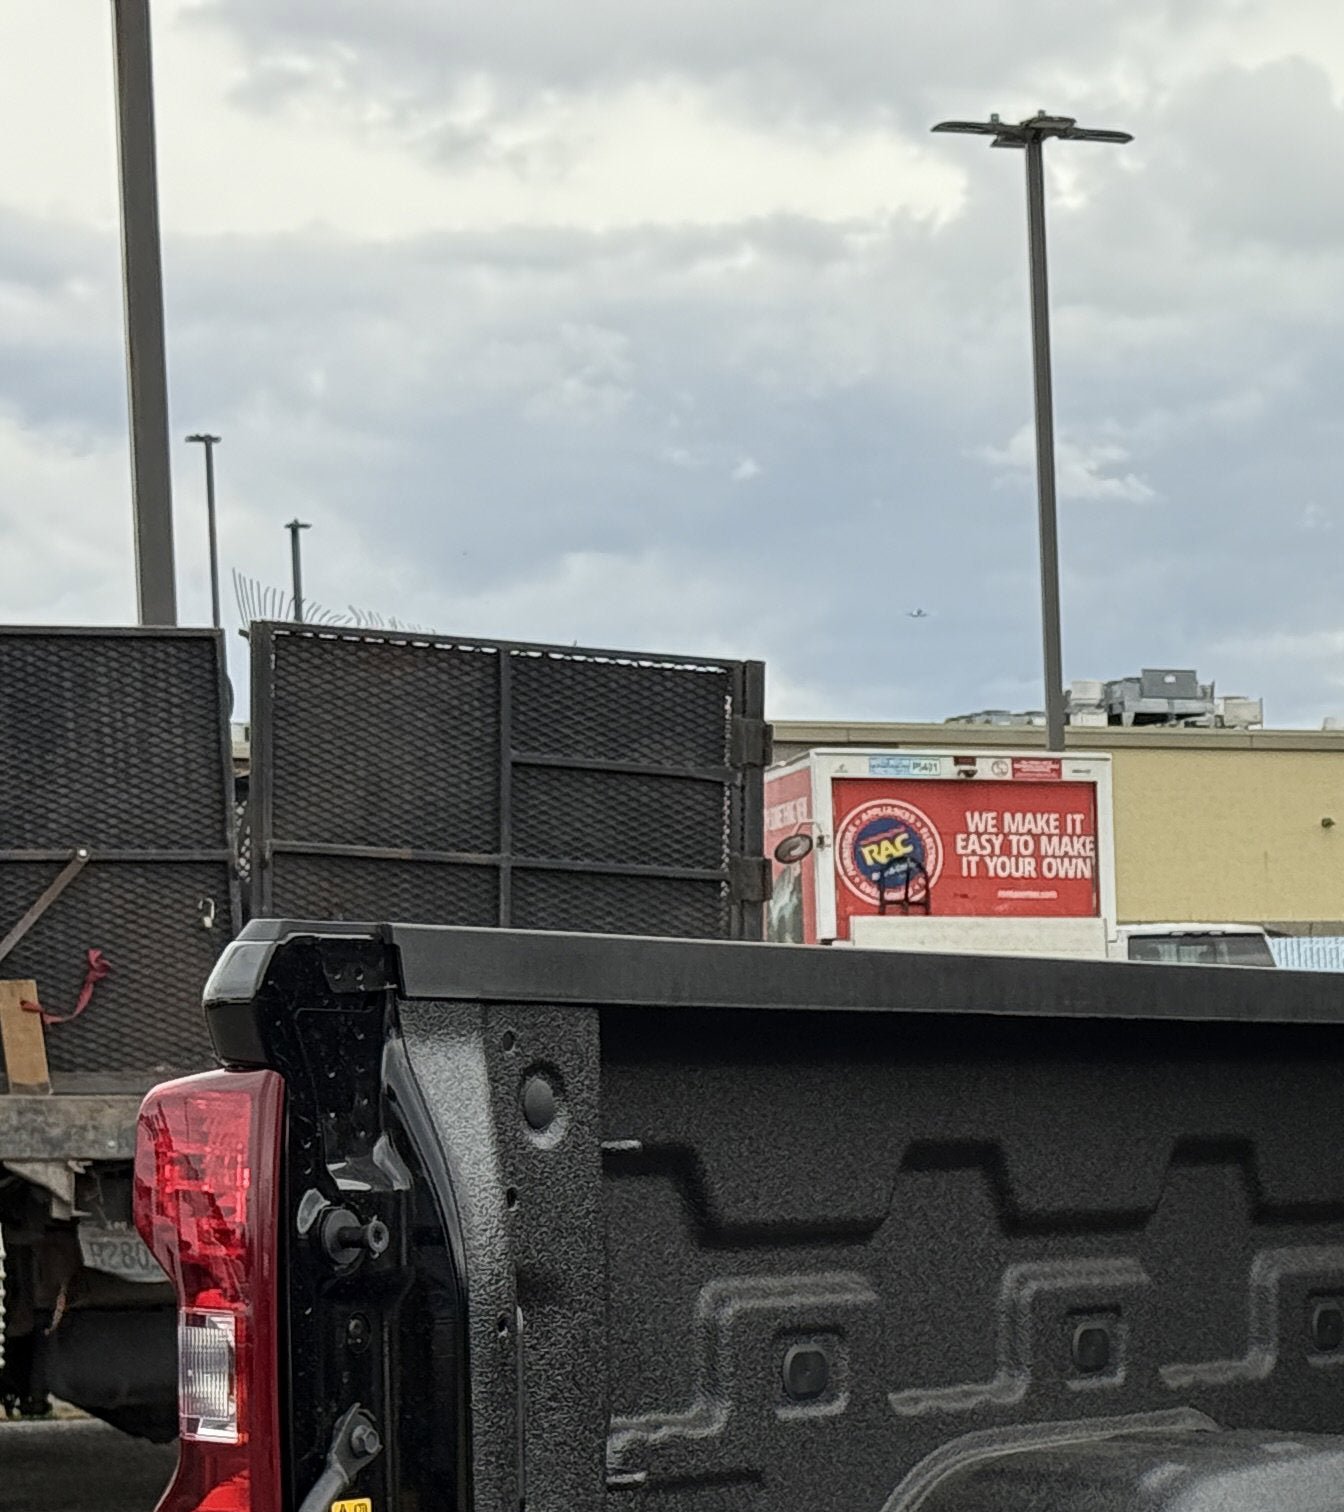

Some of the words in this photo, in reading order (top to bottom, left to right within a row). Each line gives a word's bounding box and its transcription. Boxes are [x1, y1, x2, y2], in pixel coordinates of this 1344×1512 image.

[965, 811, 998, 833] WE
[1003, 812, 1060, 834] MAKE
[1066, 813, 1085, 835] IT
[861, 833, 914, 866] RAC
[955, 834, 1004, 855] EASY
[1008, 835, 1034, 856] TO
[1040, 835, 1095, 857] MAKE
[962, 856, 979, 877] IT
[984, 856, 1037, 878] YOUR
[1042, 857, 1092, 879] OWN
